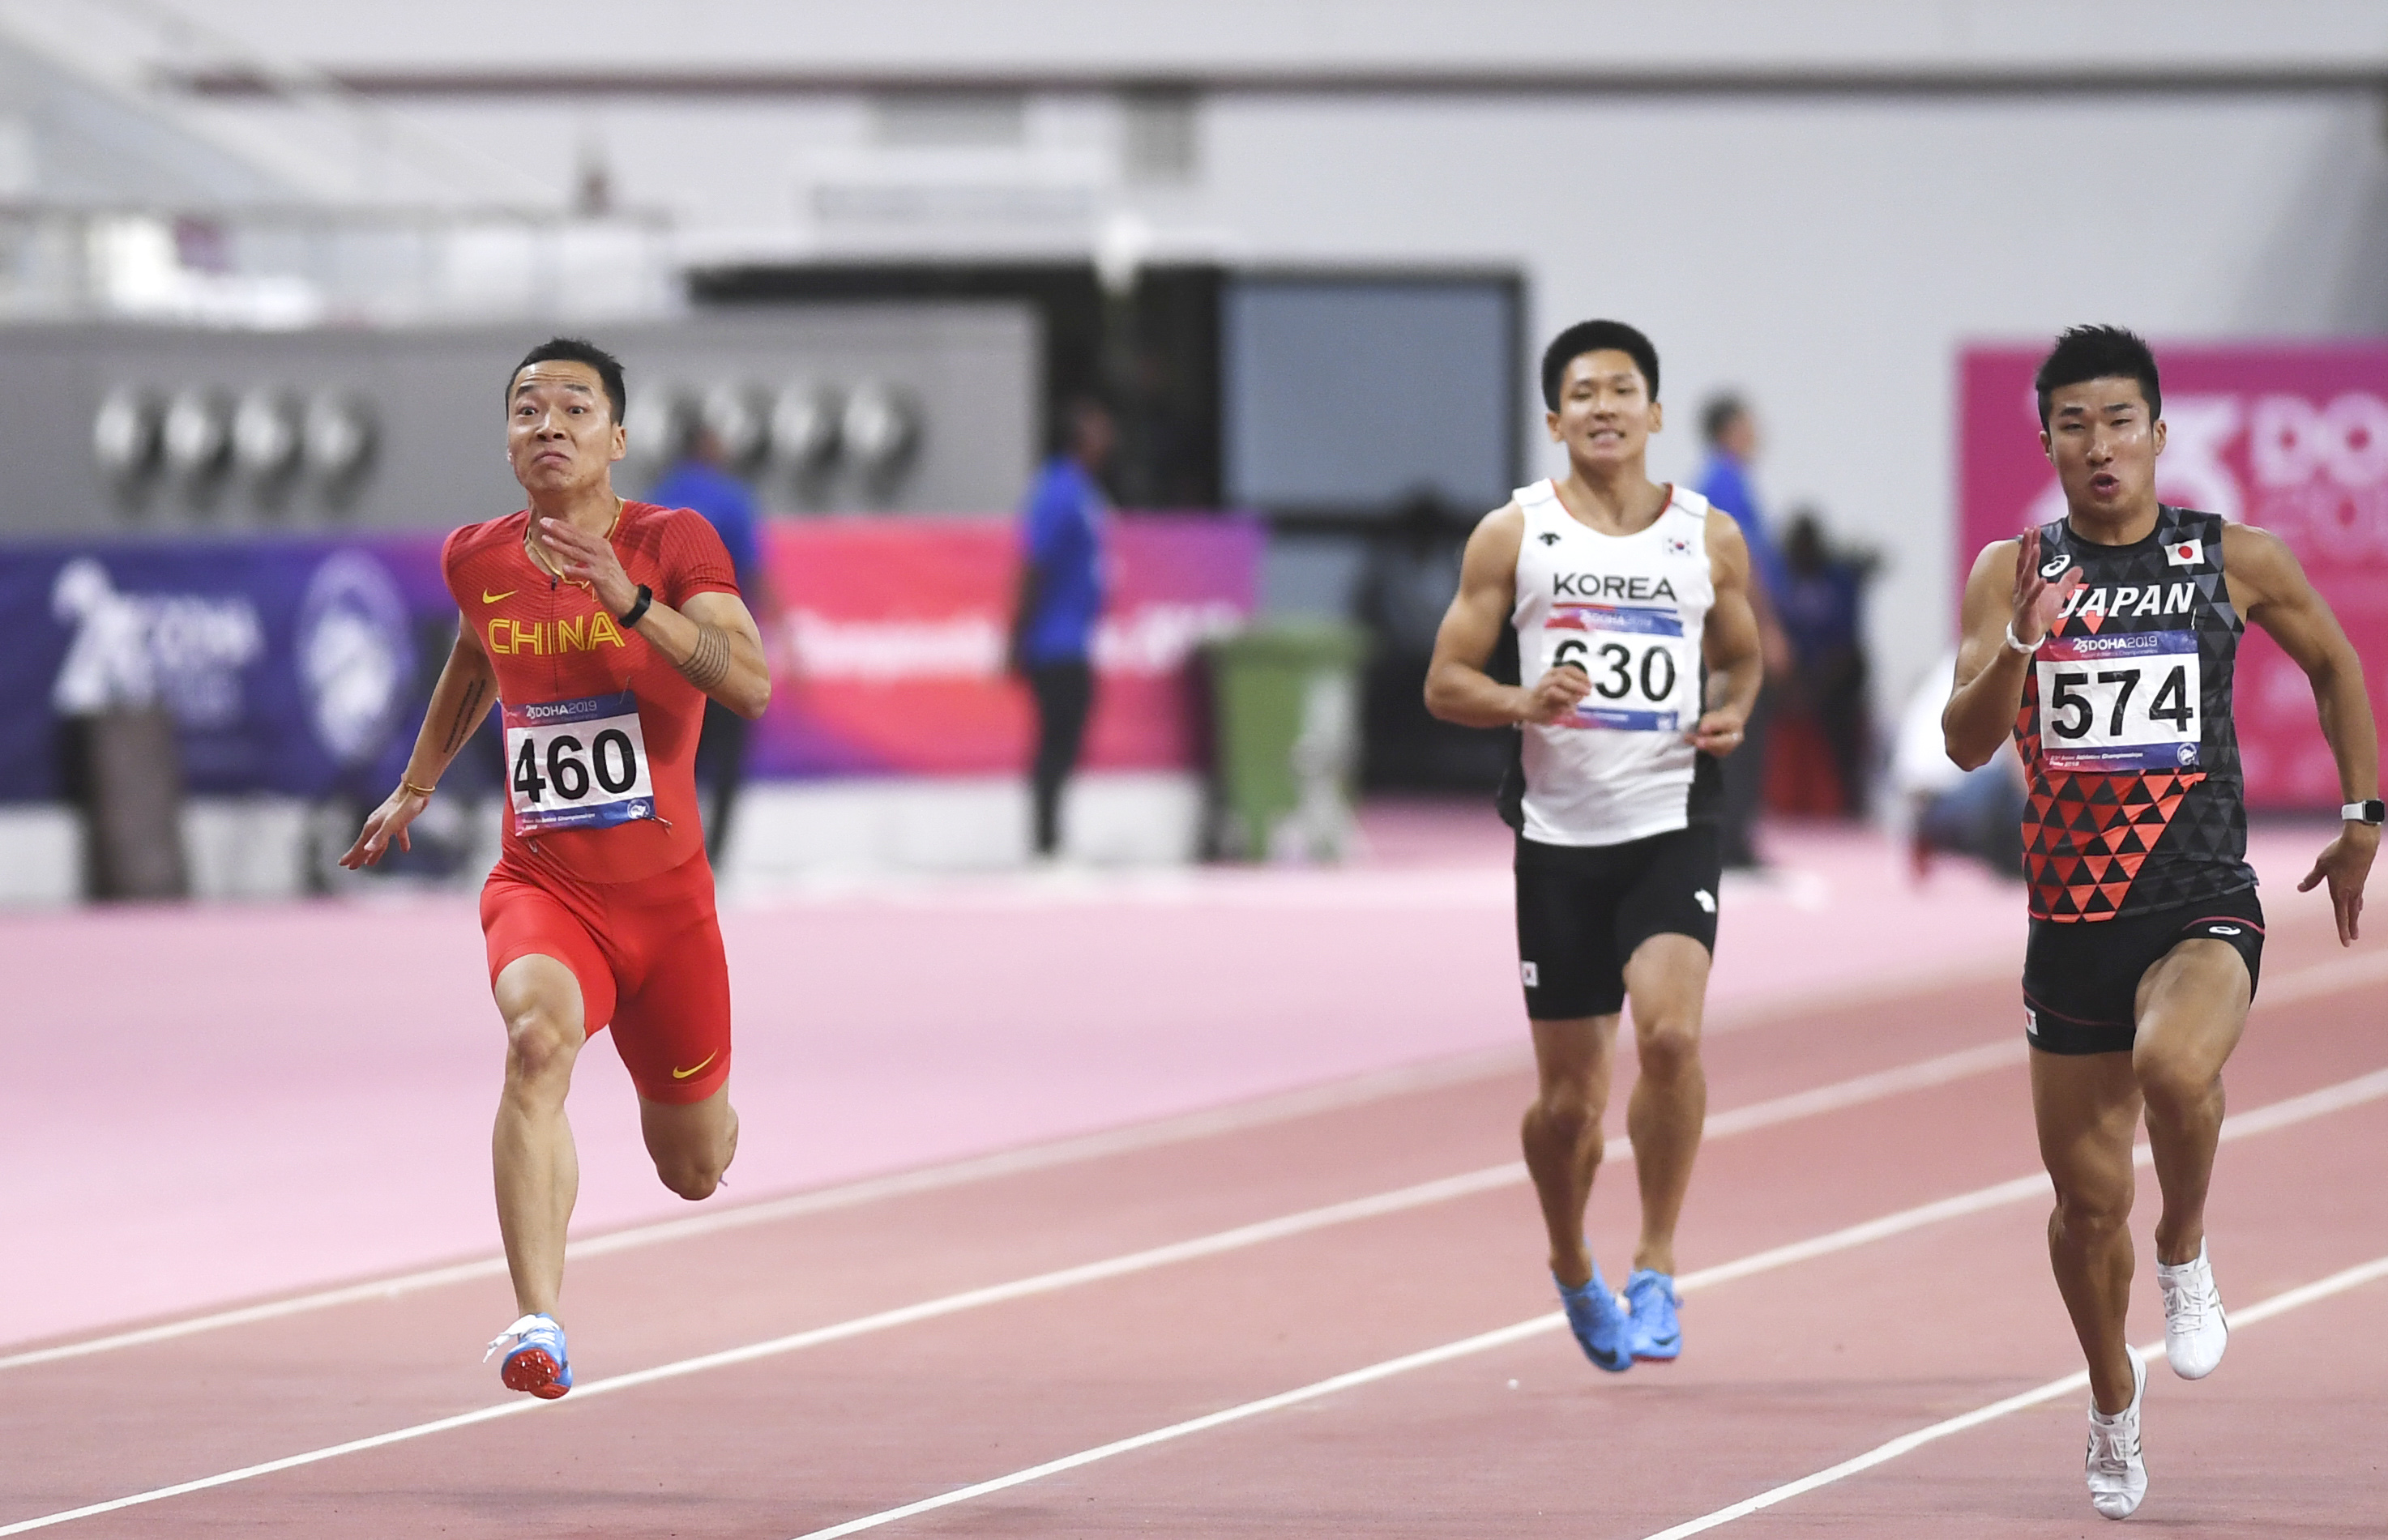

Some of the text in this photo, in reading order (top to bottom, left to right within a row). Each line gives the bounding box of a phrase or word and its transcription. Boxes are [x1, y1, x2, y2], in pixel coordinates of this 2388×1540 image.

[1553, 572, 1677, 602] KOREA
[2057, 582, 2197, 620] JAPAN
[489, 612, 626, 655] CHINA
[1551, 639, 1676, 702] 630
[2051, 665, 2194, 740] 574
[514, 729, 637, 803] 460
